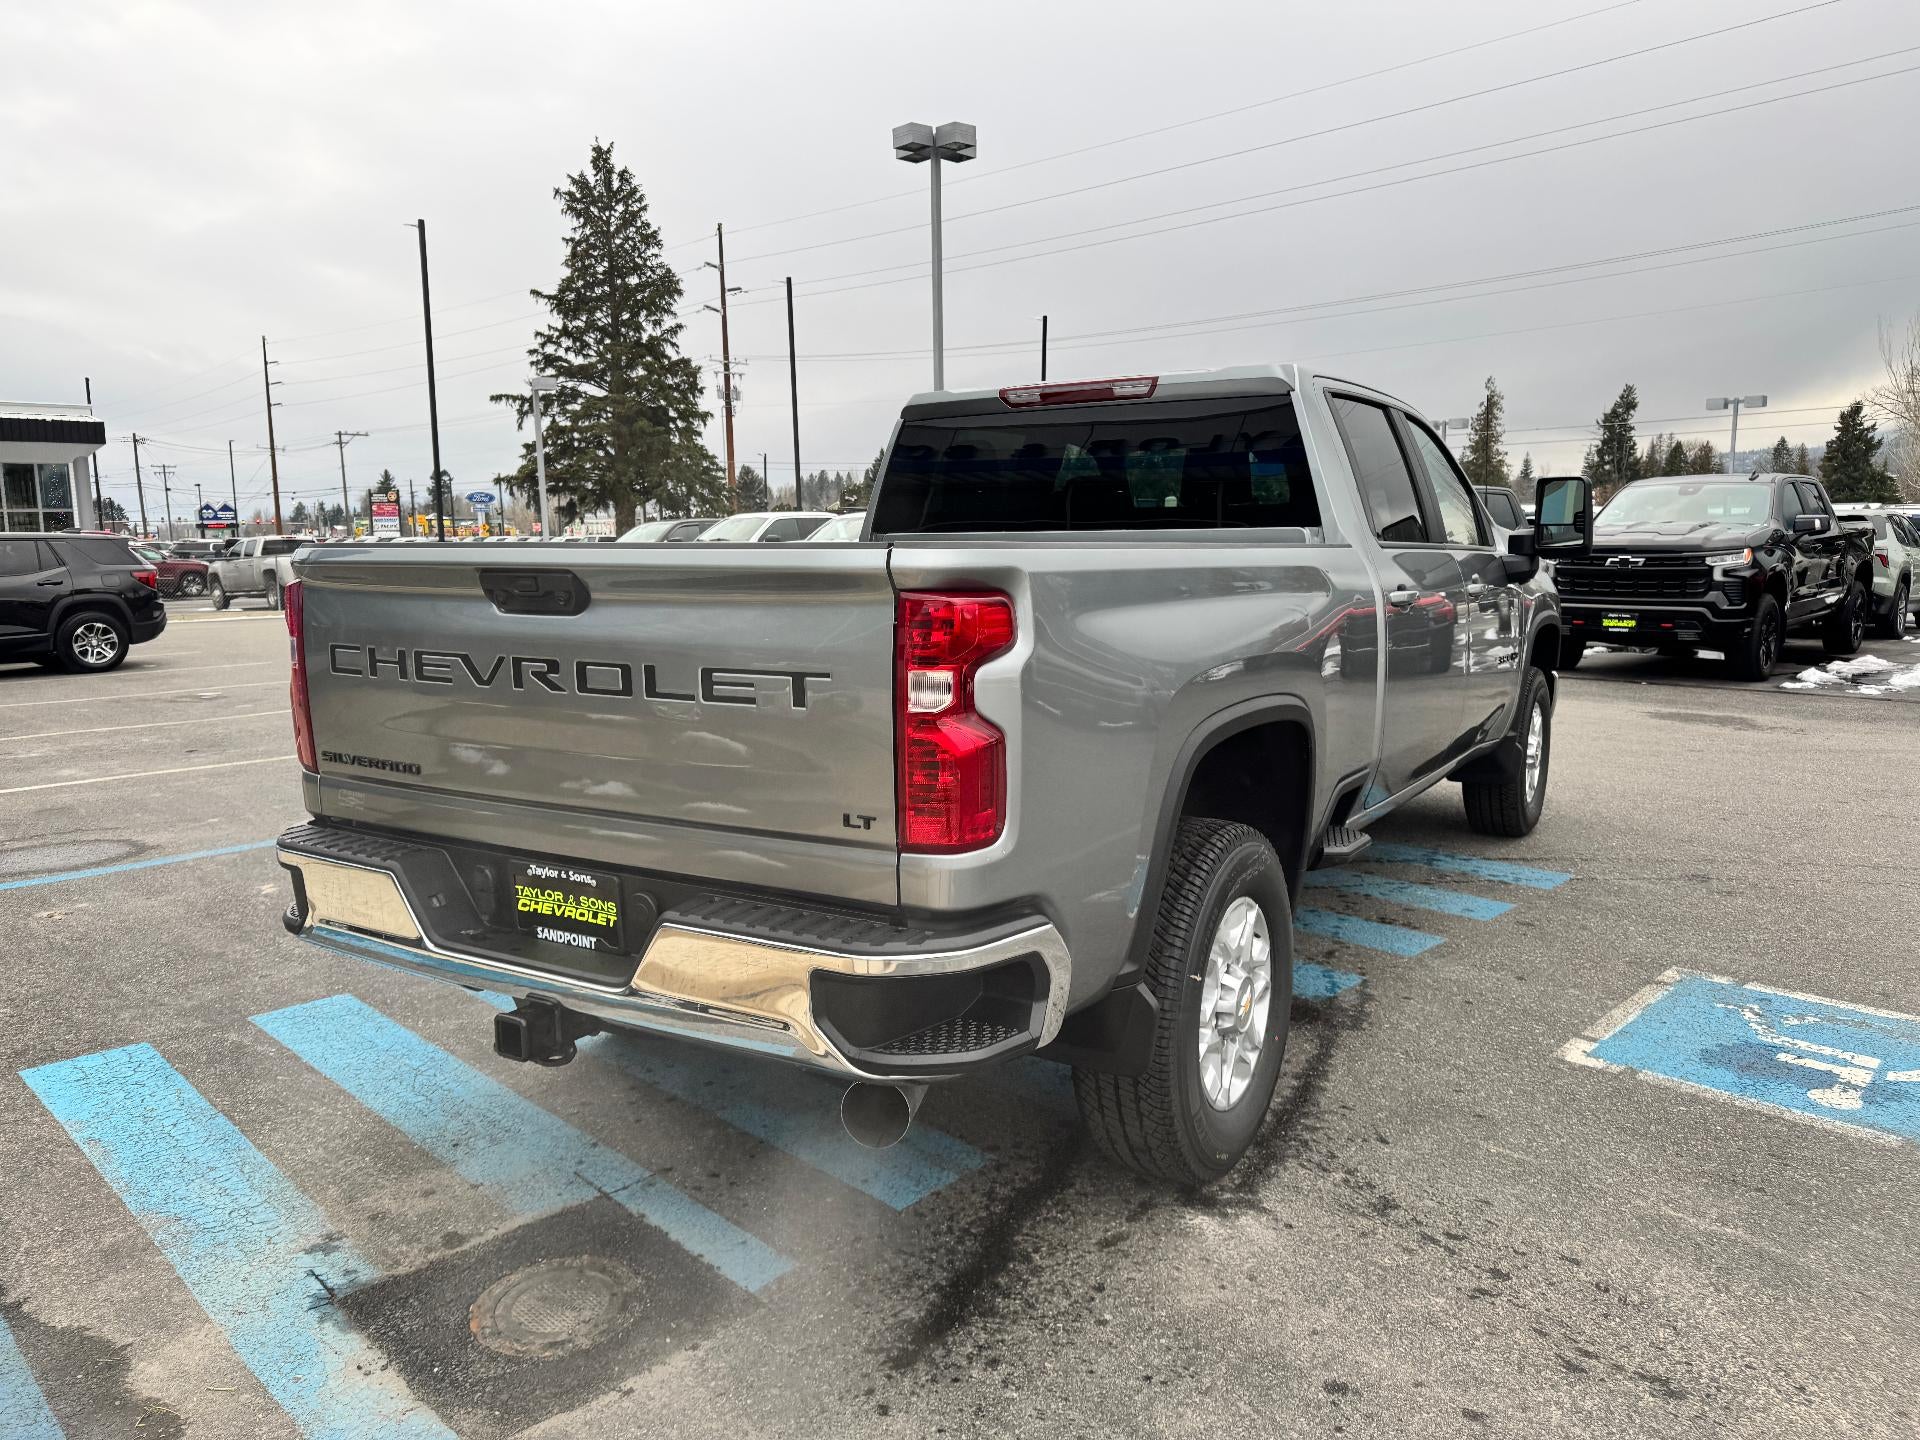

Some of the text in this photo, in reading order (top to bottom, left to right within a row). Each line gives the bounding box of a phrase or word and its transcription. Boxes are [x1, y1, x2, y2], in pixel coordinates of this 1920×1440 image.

[472, 492, 490, 502] Ford
[328, 643, 832, 710] CHEVROLET
[321, 751, 422, 775] SILVERADO
[843, 813, 877, 830] LT
[529, 864, 559, 878] Taylor
[569, 871, 592, 884] Sons
[515, 885, 617, 913] TAYLOR & SONS
[517, 898, 617, 927] CHEVROLET
[536, 926, 597, 950] SANDPOINT
